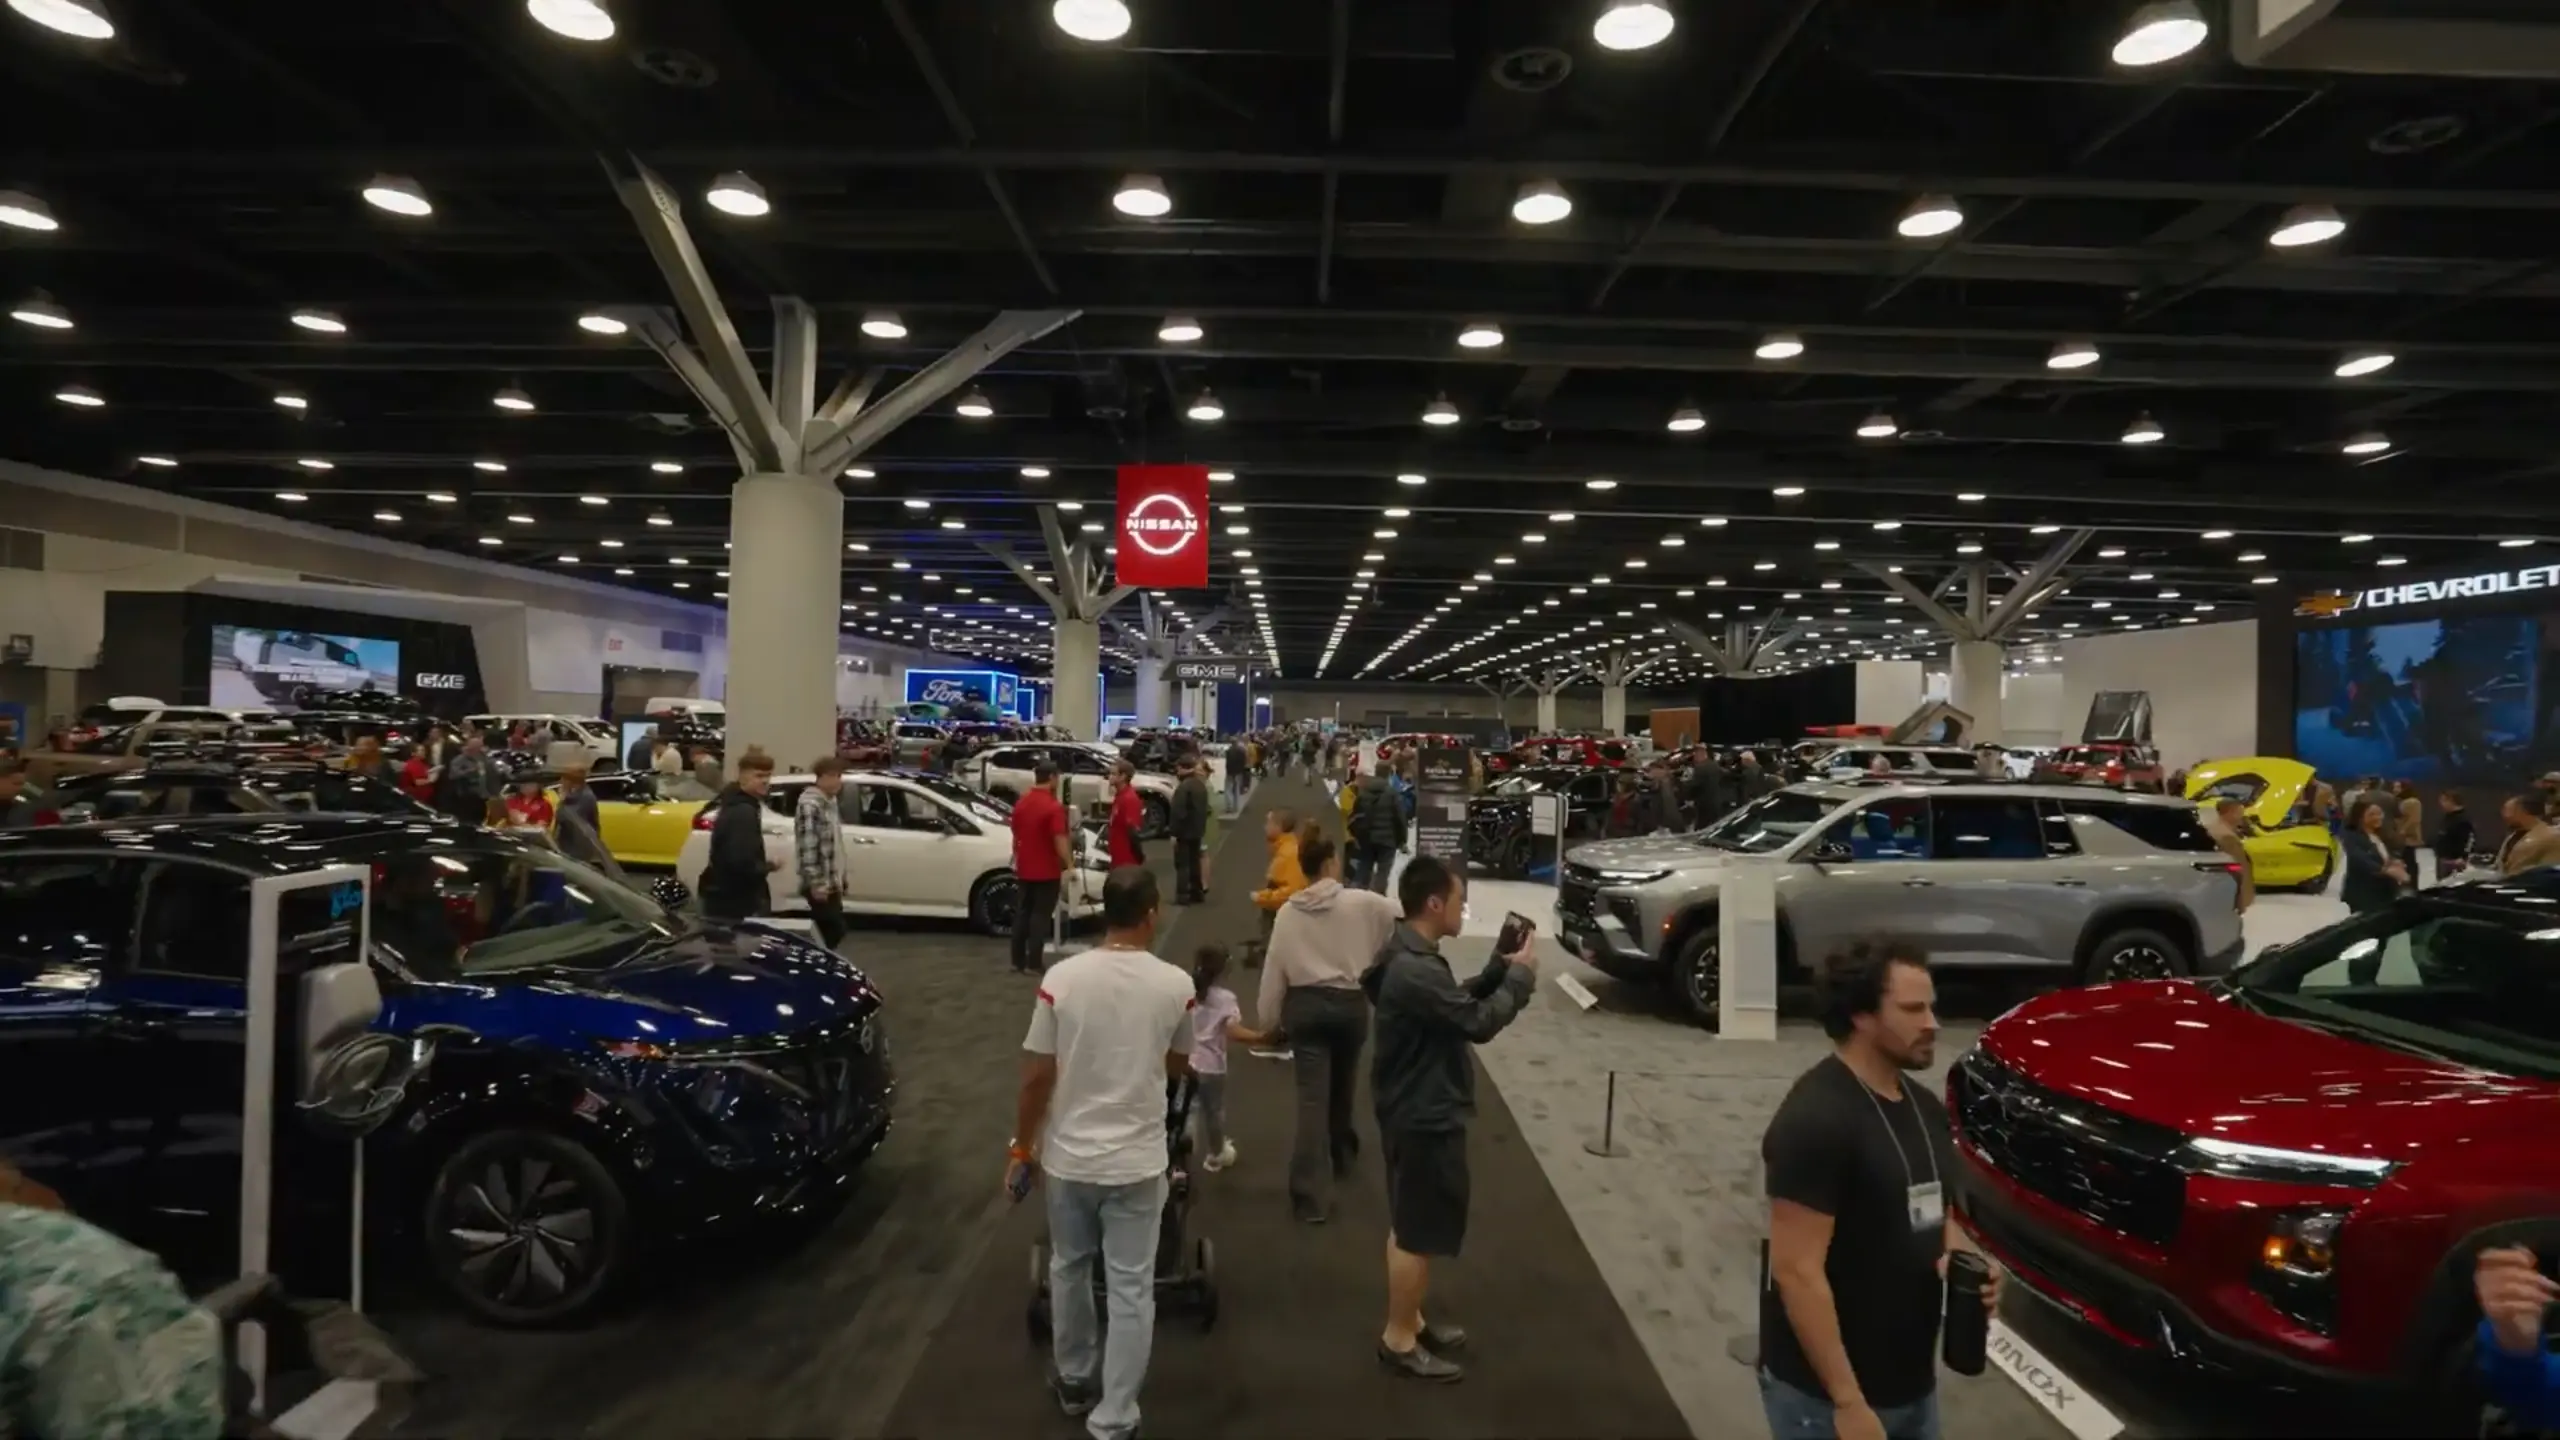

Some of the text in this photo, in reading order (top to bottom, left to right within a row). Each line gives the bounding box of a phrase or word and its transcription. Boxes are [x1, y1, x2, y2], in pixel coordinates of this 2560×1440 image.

[1126, 518, 1198, 530] NISSAN
[2366, 564, 2560, 608] CHEVROLET
[1176, 664, 1236, 678] GMC
[416, 672, 466, 689] GMC
[922, 680, 967, 703] For
